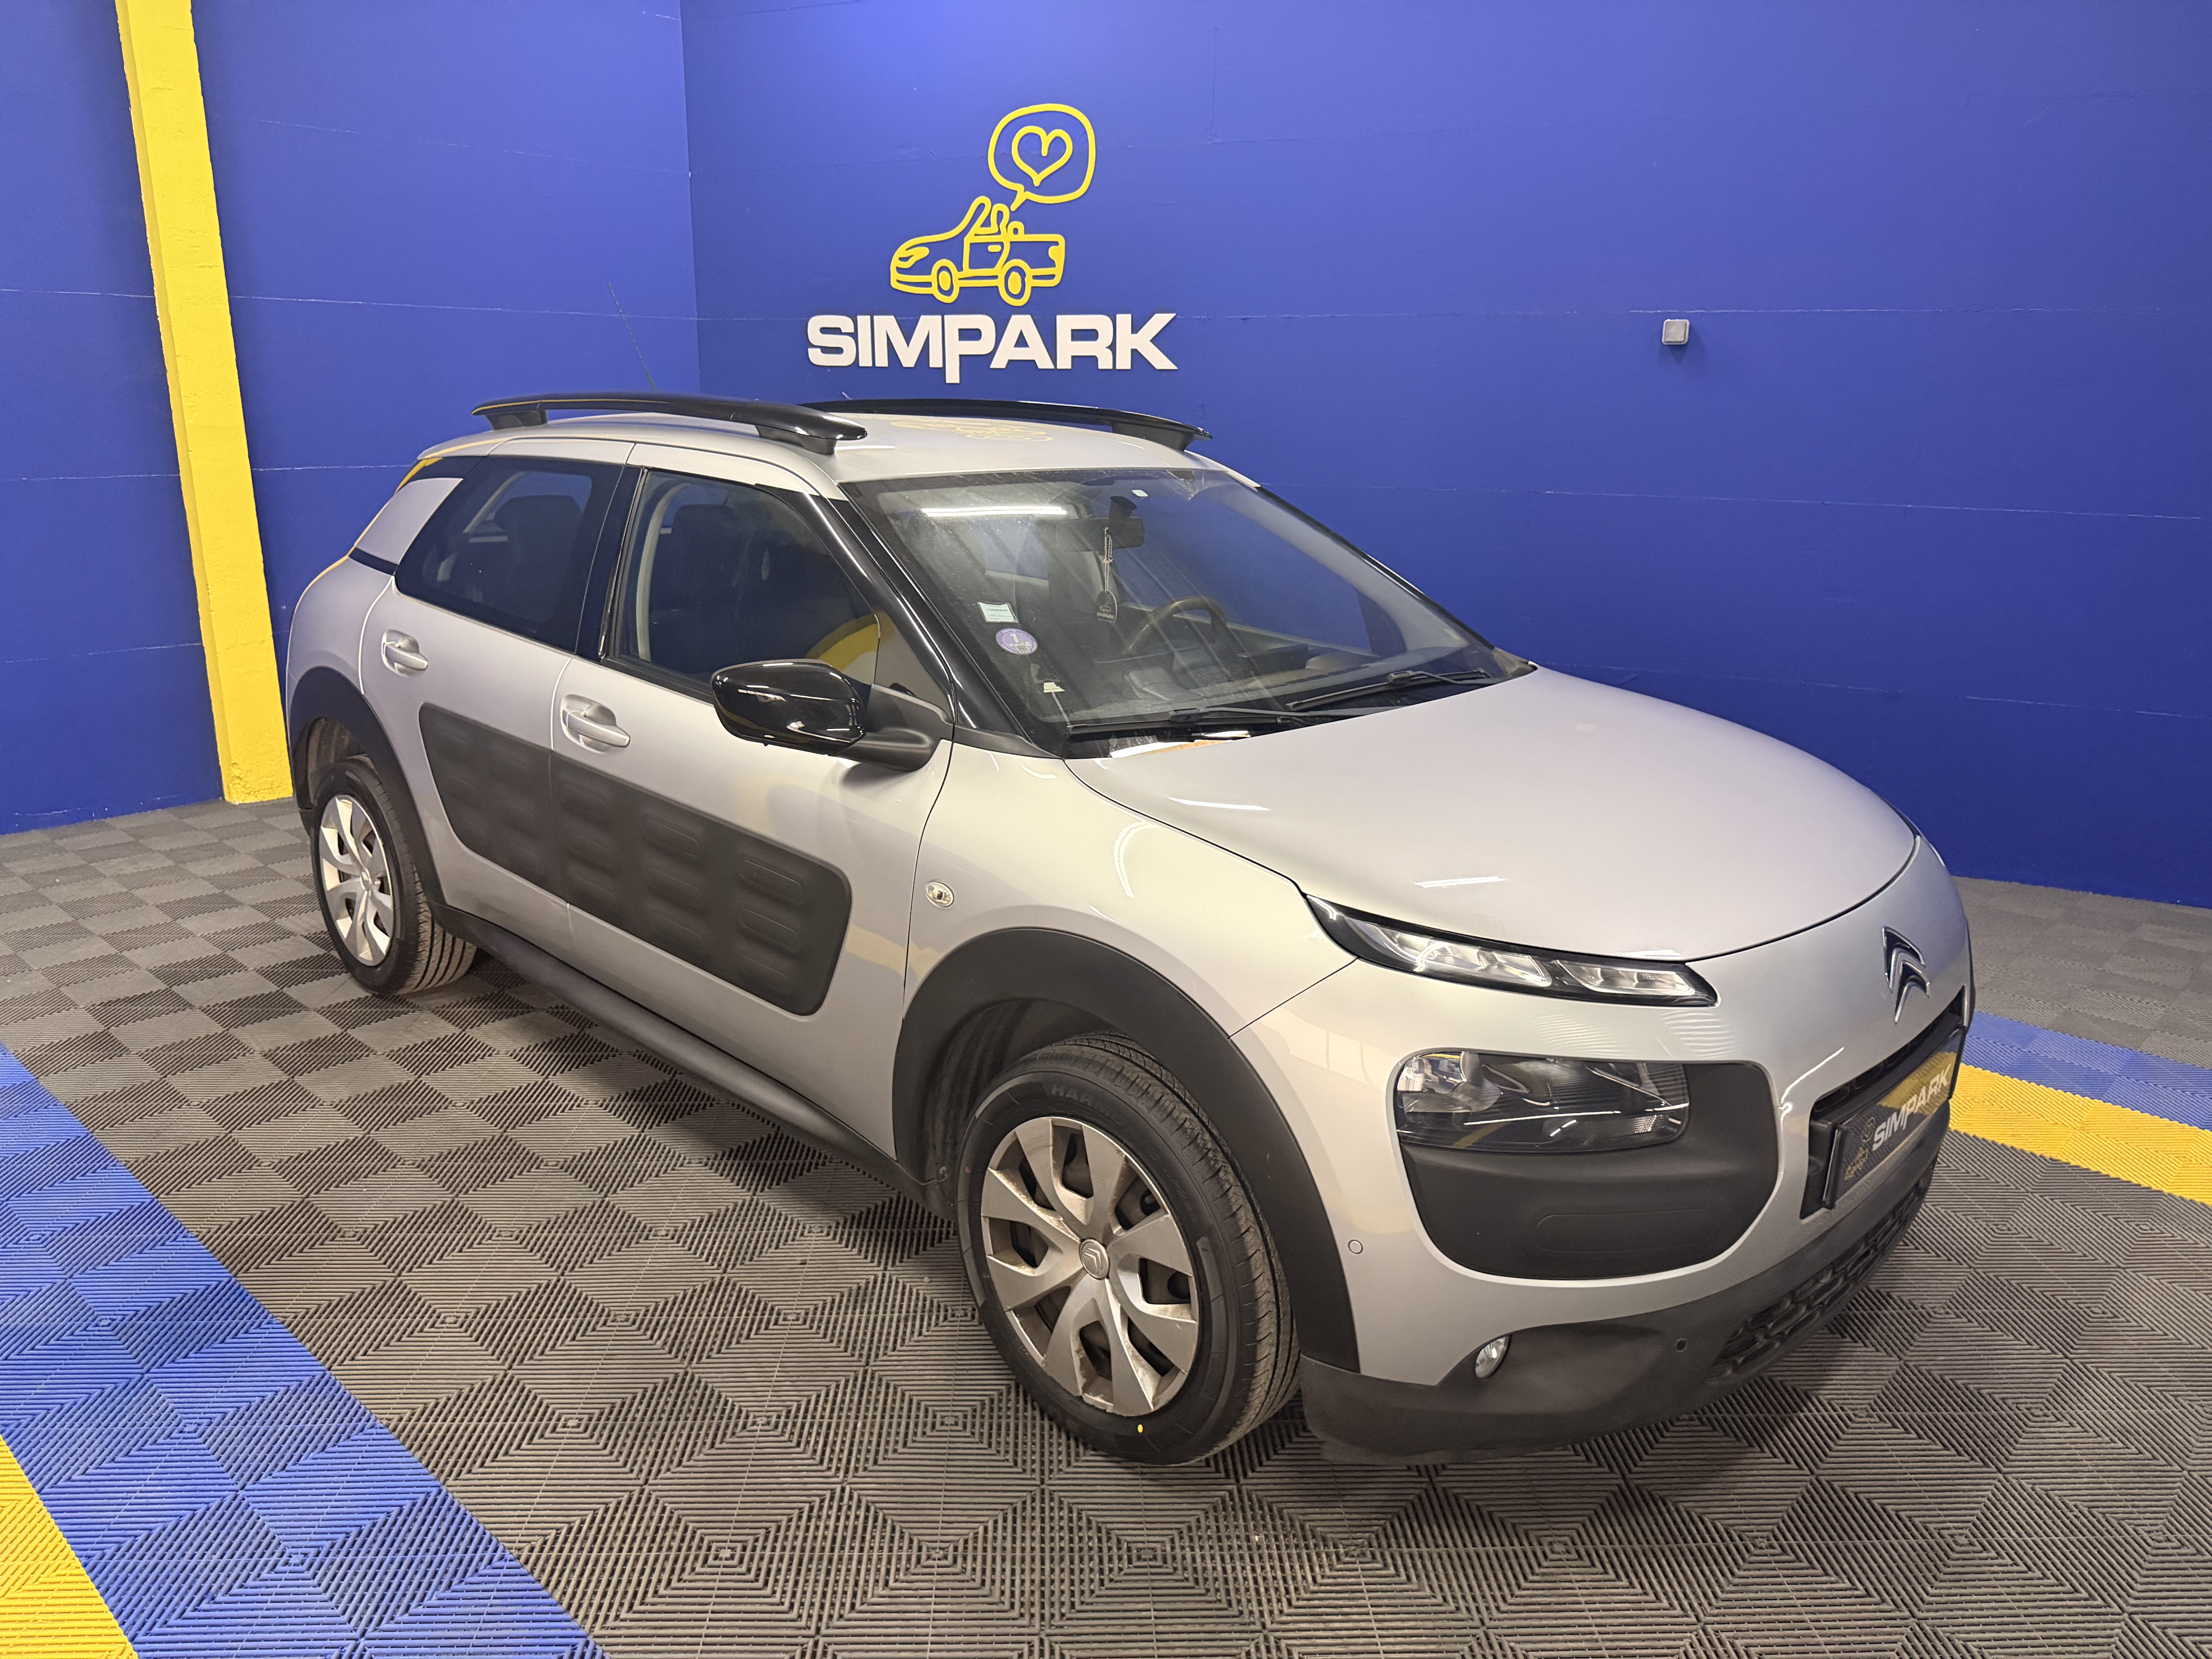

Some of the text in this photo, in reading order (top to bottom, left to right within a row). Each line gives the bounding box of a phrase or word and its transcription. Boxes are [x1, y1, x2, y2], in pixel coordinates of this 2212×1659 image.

[807, 313, 1178, 383] SIMPARK
[1010, 633, 1019, 642] 1
[1872, 1063, 1953, 1151] SIMPARK
